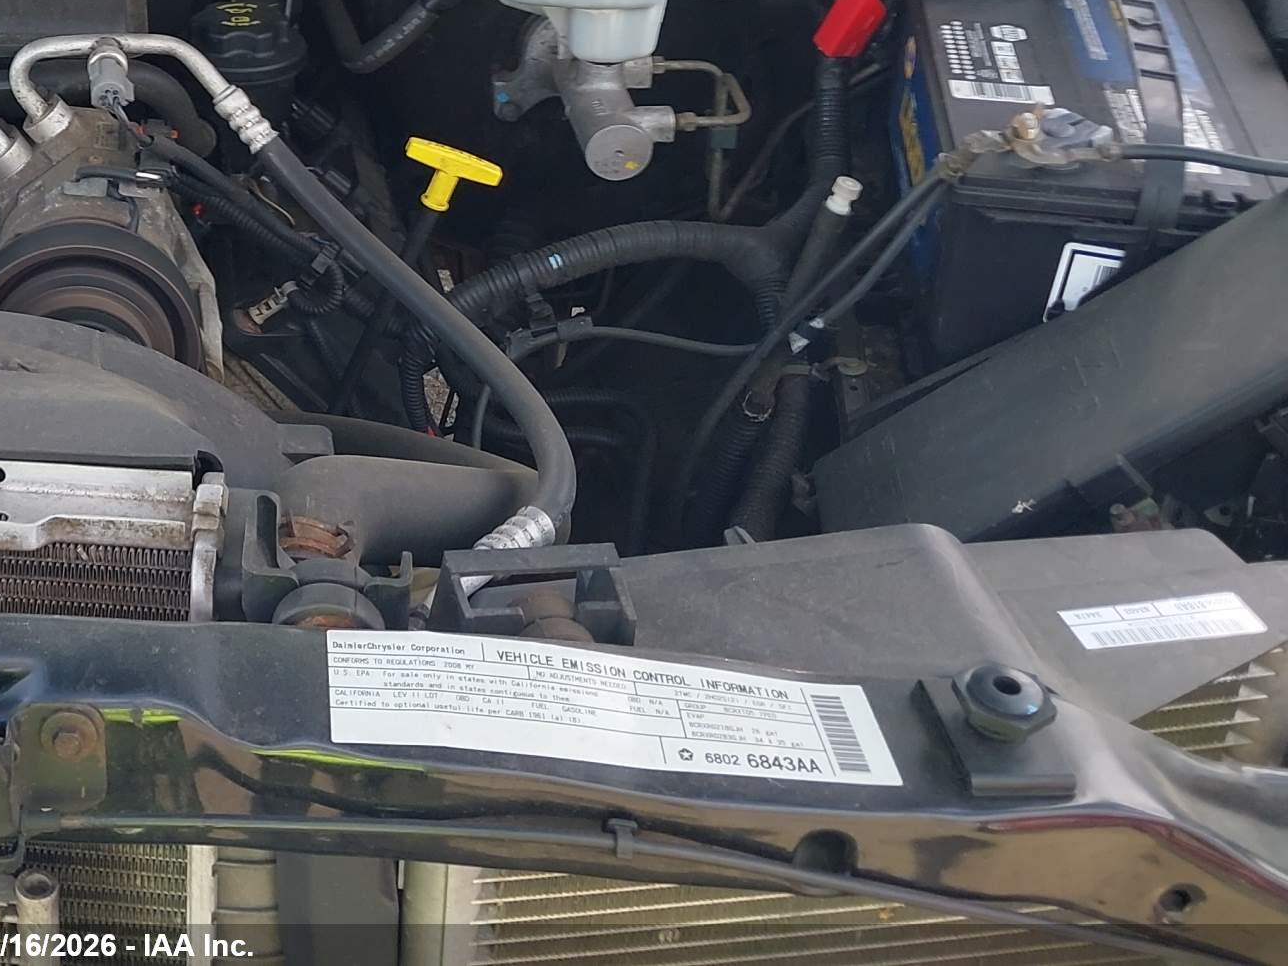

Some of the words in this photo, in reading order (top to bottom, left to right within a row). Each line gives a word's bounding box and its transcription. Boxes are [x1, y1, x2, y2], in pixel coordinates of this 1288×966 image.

[332, 641, 405, 651] DaimlerChrysler
[411, 644, 465, 655] Corporation
[333, 657, 369, 665] CONFORMS
[497, 650, 554, 667] VEHICLE
[562, 658, 626, 678] EMISSION
[633, 670, 692, 687] CONTROL
[700, 678, 789, 700] INFORMATION
[549, 672, 597, 686] ADJUSTMENTS
[384, 681, 424, 689] standards
[460, 684, 485, 694] states
[400, 671, 419, 679] sale
[423, 673, 441, 681] only
[459, 675, 485, 684] states
[488, 677, 508, 687] with
[511, 679, 555, 690] California
[559, 686, 599, 697] emissions
[335, 699, 377, 708] Certified
[393, 701, 431, 711] optional
[434, 703, 462, 712] useful
[467, 704, 484, 713] life
[487, 707, 502, 716] per
[505, 708, 524, 716] CARB
[562, 705, 597, 717] GASOLINE
[705, 752, 741, 766] 6802
[746, 753, 823, 774] 6843AA
